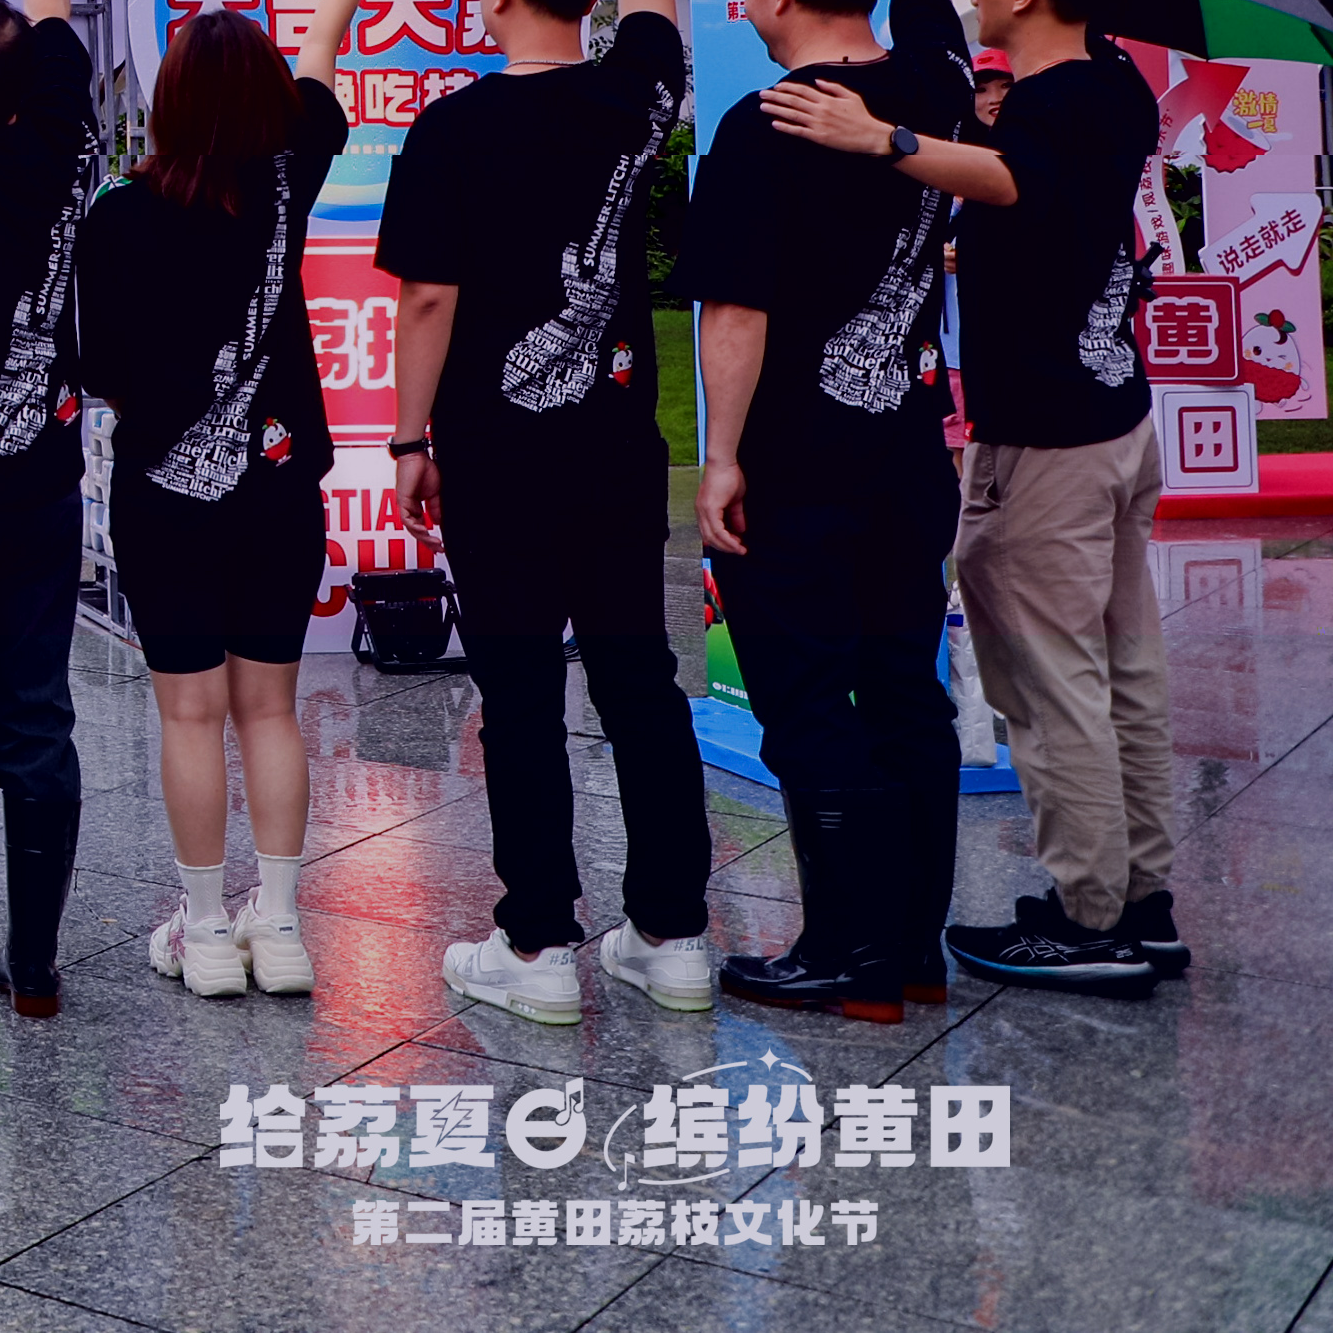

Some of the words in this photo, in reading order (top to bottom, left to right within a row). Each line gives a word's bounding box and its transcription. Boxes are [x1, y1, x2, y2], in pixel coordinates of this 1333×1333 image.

[1233, 88, 1279, 117] 激情
[1246, 113, 1278, 134] 一夏
[1217, 208, 1307, 275] 说走就走
[1146, 297, 1219, 364] 黄
[1178, 406, 1239, 473] 田
